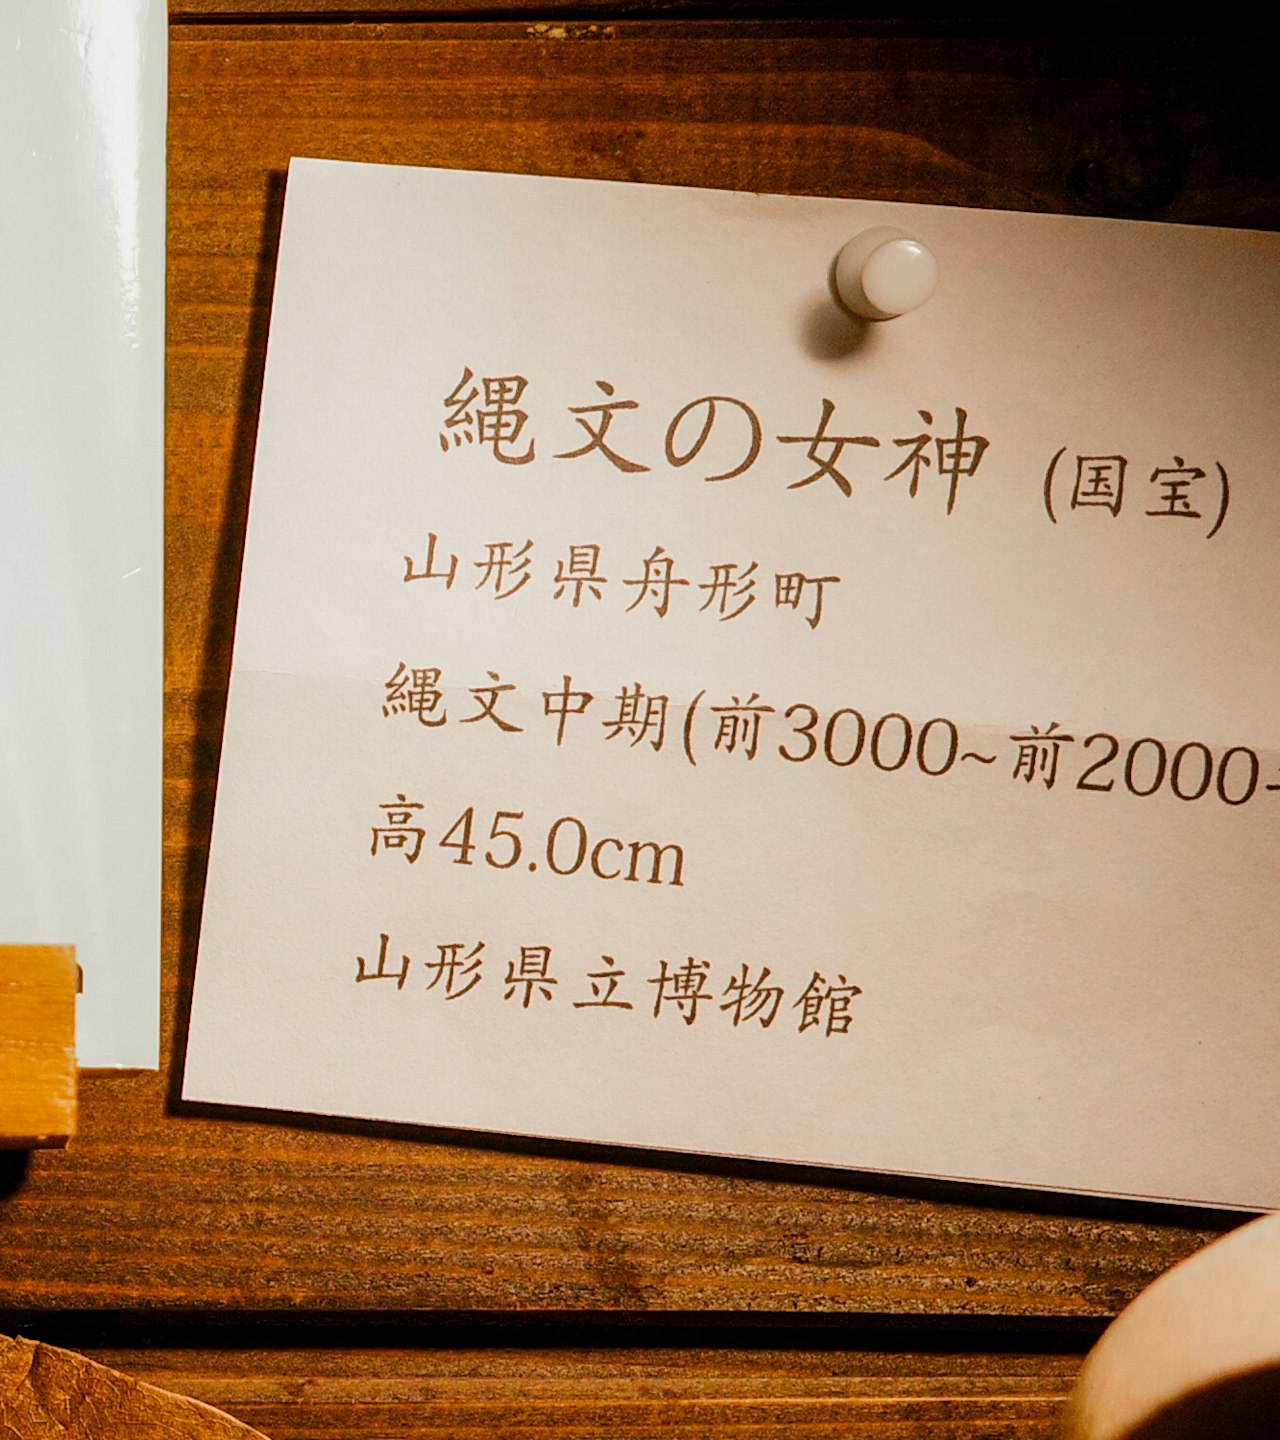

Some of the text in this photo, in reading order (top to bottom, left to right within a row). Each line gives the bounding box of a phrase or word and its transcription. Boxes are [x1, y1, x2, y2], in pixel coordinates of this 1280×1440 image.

[438, 366, 1232, 539] 縄文の女神 (国宝)
[400, 532, 842, 631] 山形県舟形町
[368, 792, 686, 887] 高45.0cm
[353, 932, 865, 1039] 山形県立博物館
